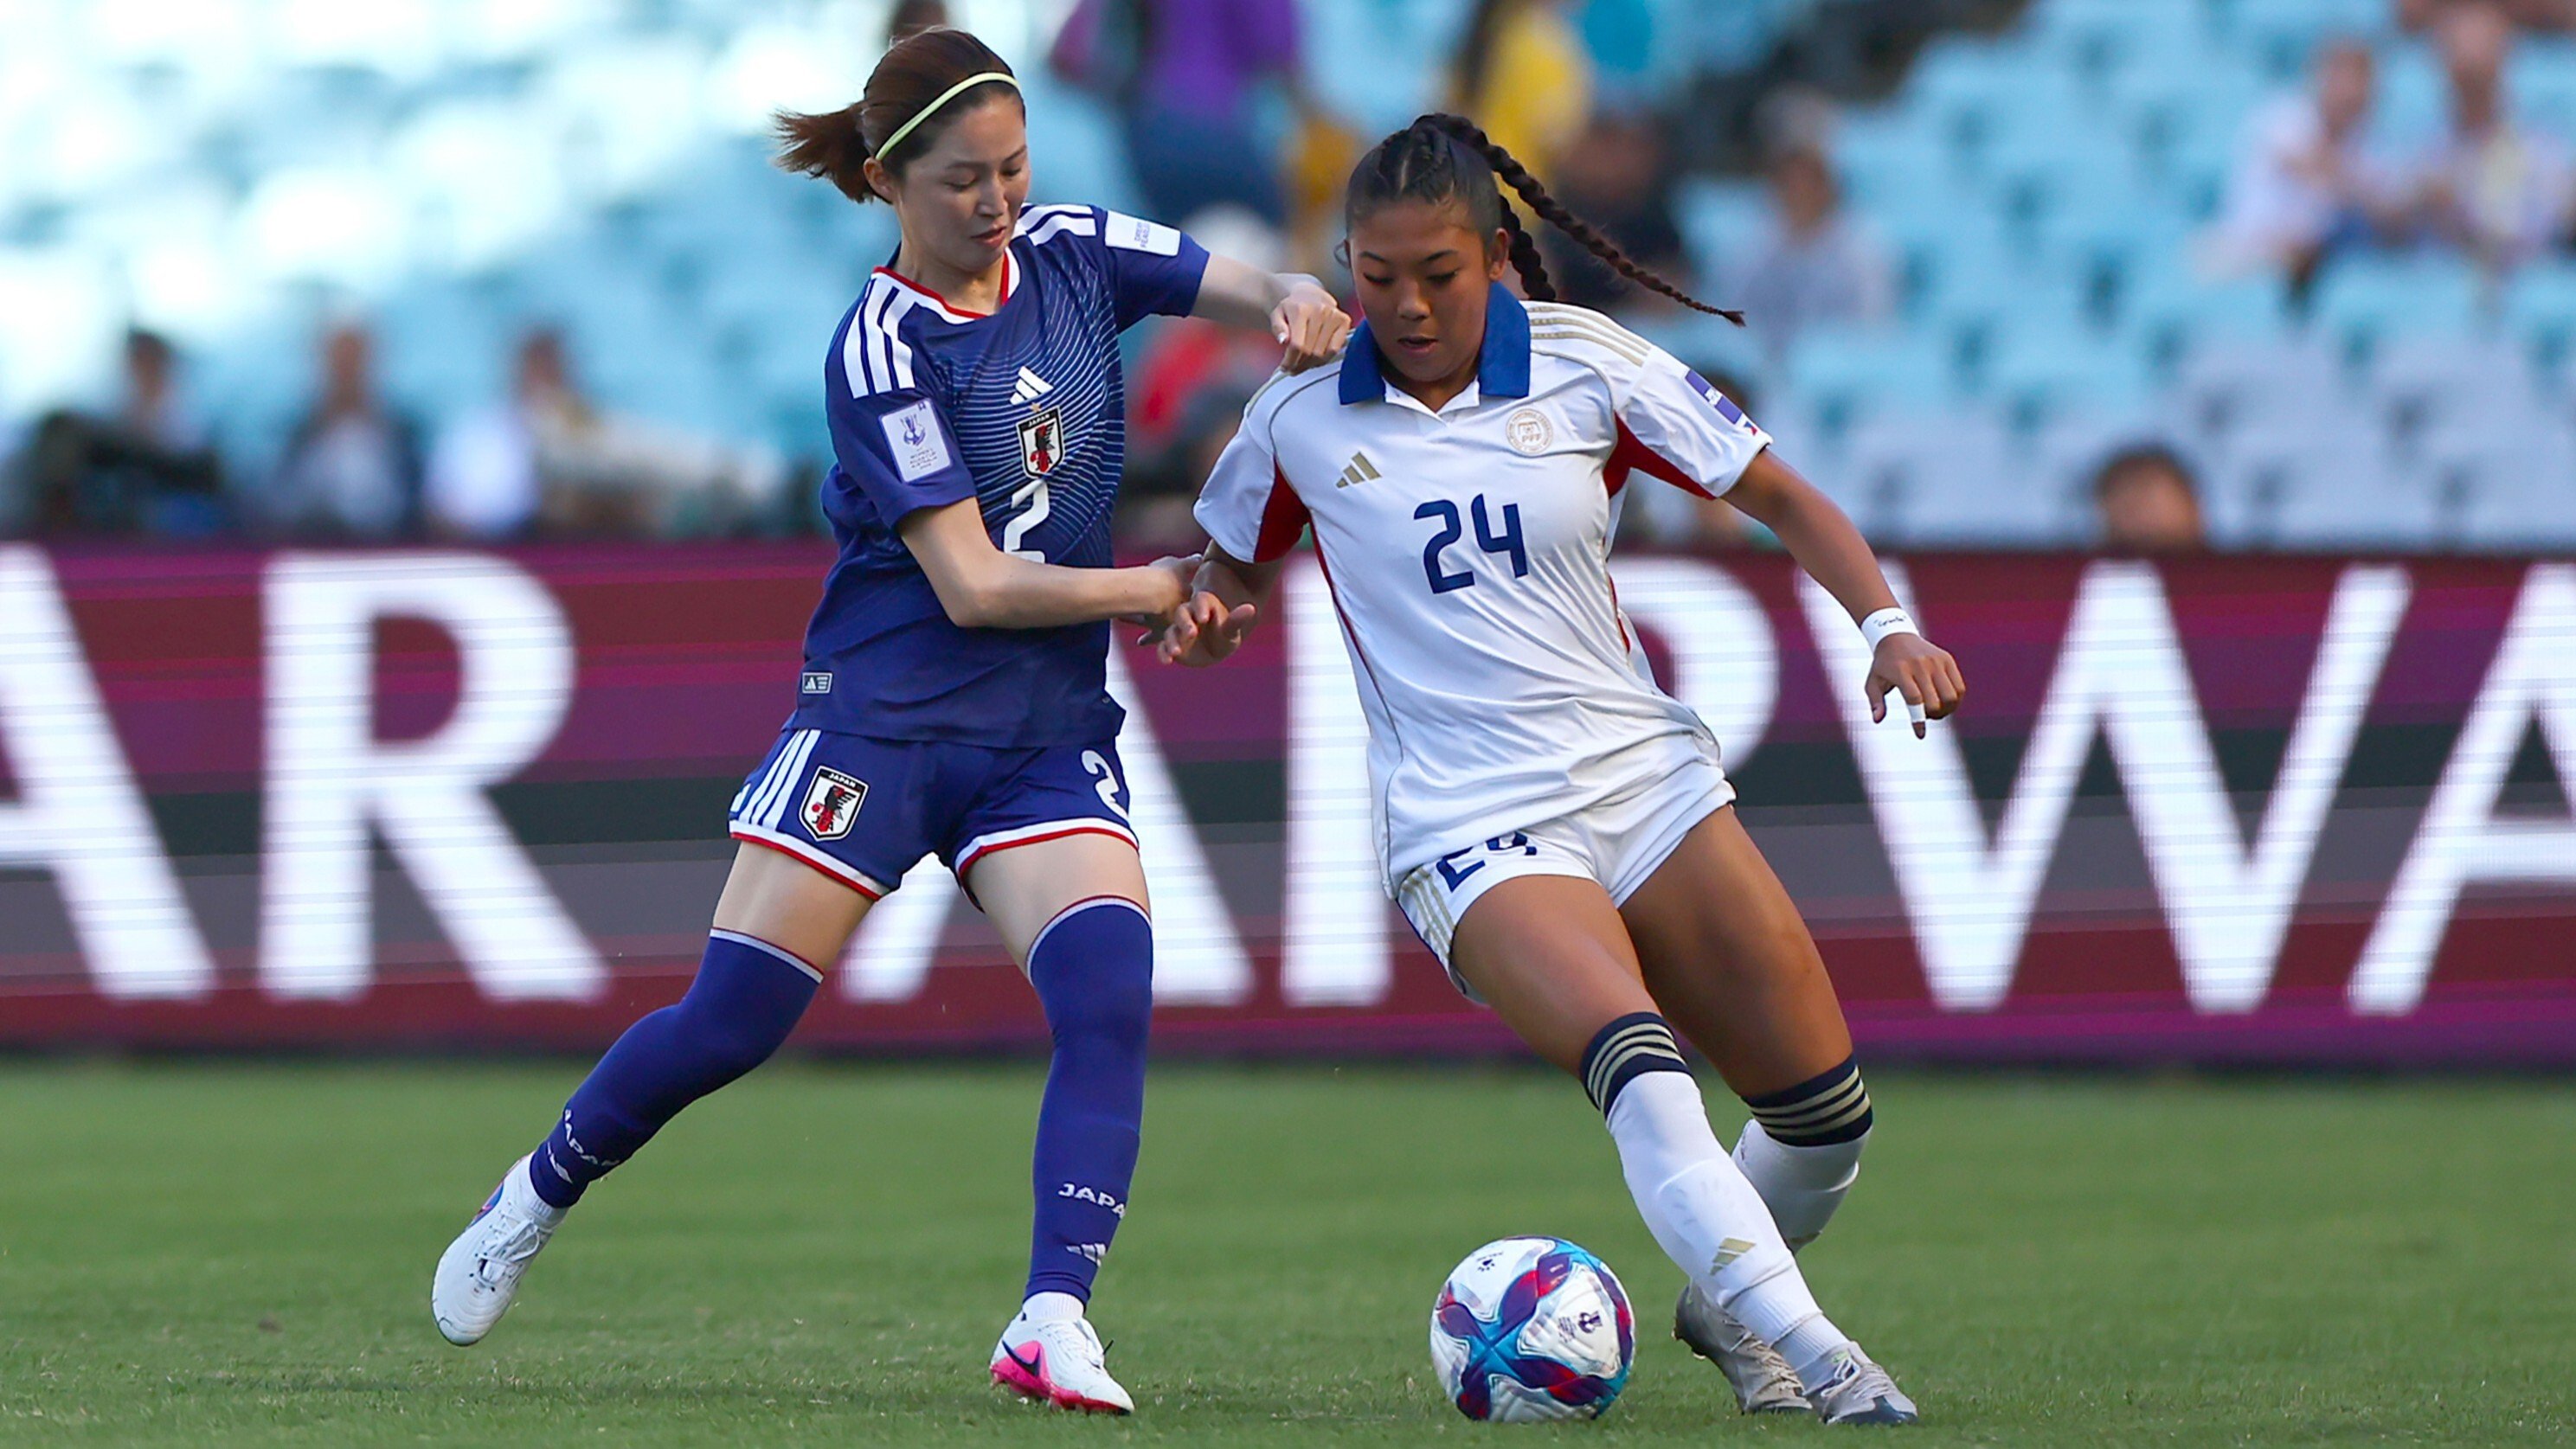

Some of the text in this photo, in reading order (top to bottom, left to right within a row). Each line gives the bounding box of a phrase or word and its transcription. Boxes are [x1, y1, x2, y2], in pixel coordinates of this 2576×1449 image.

[1028, 414, 1050, 427] JAPAN
[1004, 479, 1050, 563] 2
[1414, 493, 1528, 594] 24
[829, 773, 857, 788] JAPAN
[1082, 749, 1128, 818] 2
